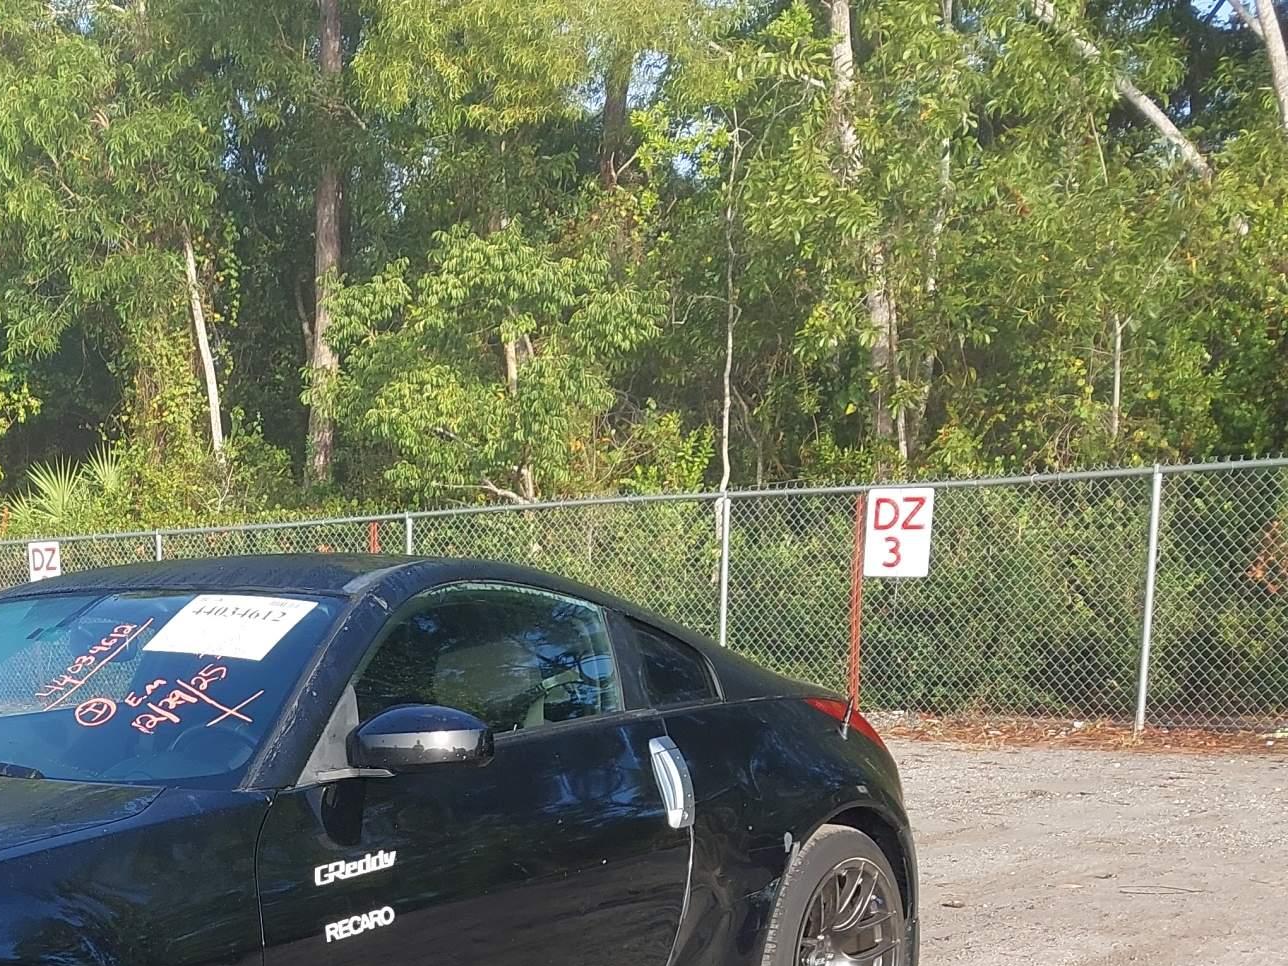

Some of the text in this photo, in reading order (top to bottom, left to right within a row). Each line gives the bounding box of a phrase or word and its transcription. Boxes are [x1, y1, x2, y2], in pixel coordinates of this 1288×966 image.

[874, 496, 927, 530] DZ
[31, 547, 57, 571] DZ
[882, 536, 902, 568] 3
[192, 605, 287, 622] 44034612
[325, 905, 395, 943] RECARO
